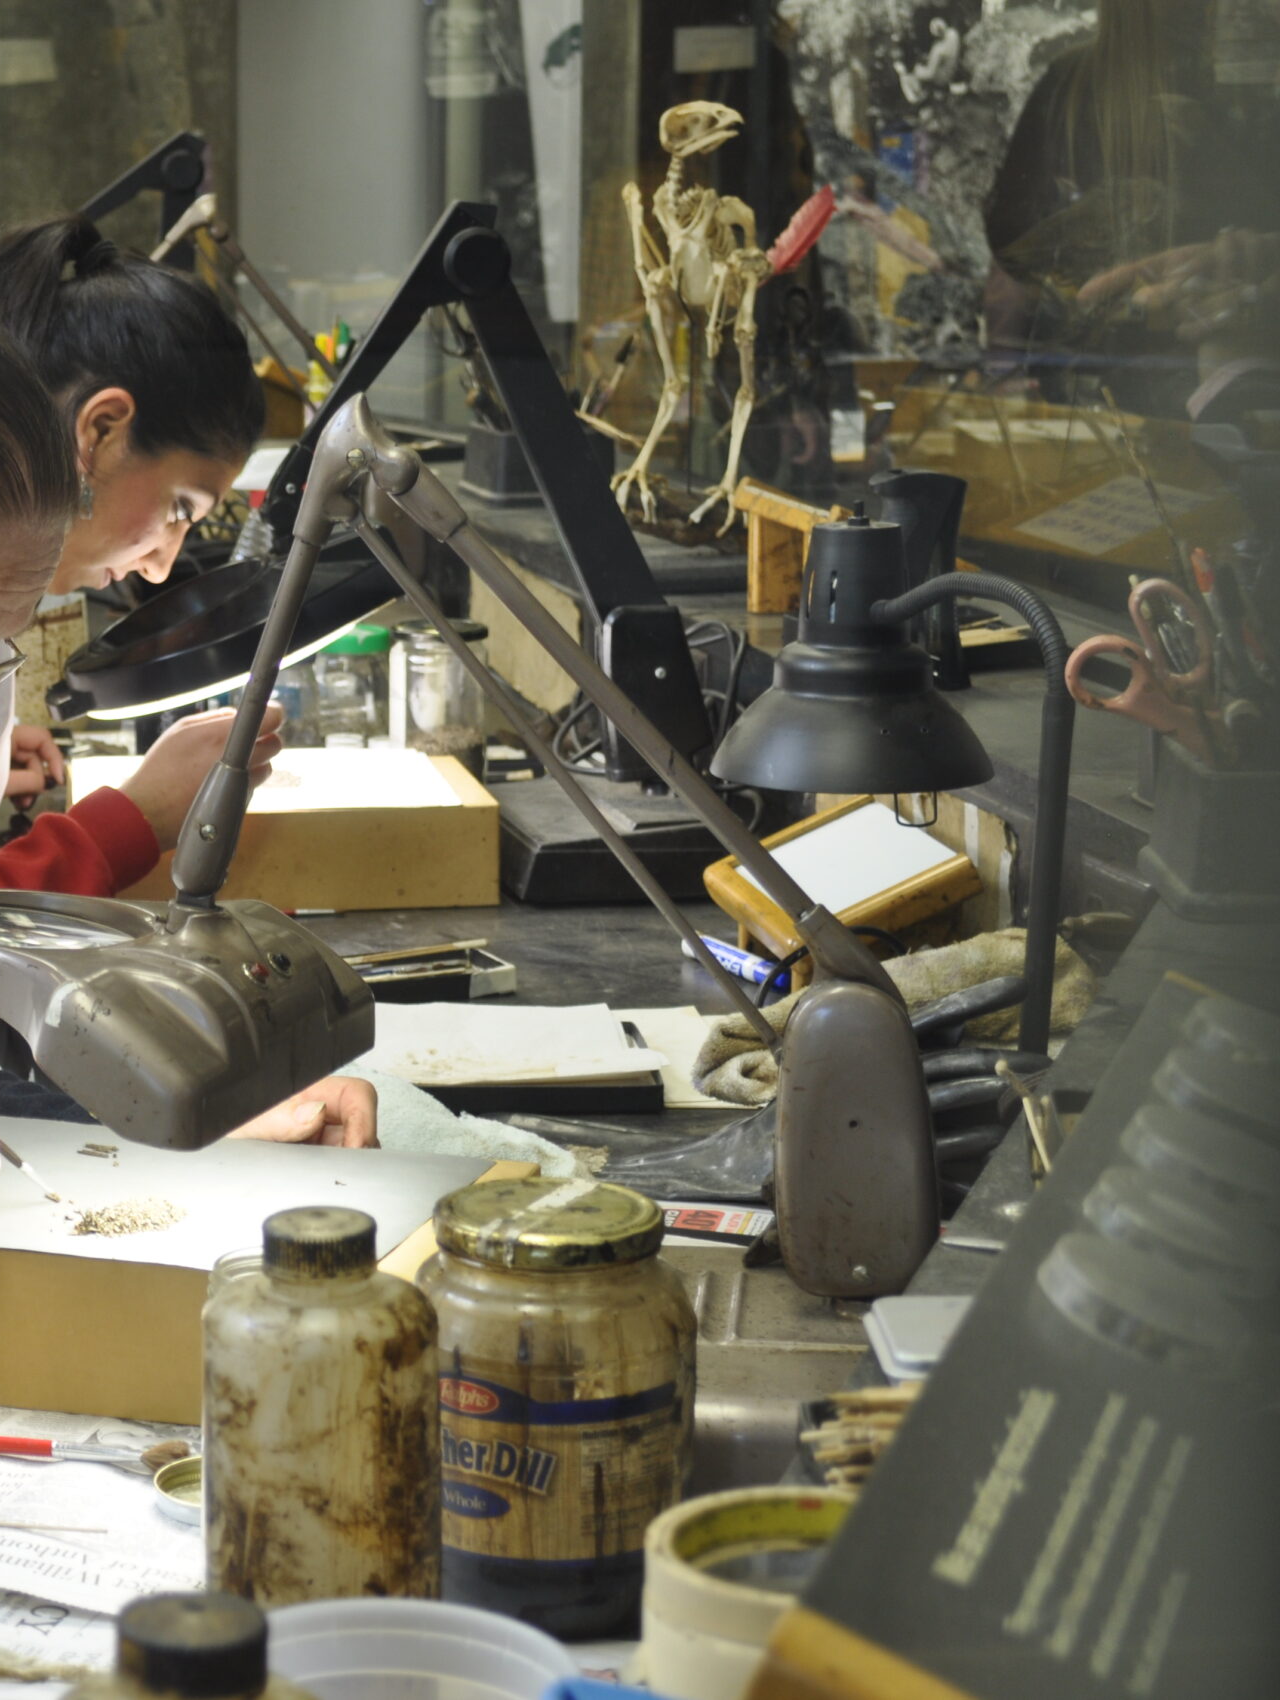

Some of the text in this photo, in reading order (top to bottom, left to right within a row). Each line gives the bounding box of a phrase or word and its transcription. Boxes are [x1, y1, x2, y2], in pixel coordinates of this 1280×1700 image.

[441, 1427, 490, 1474] her
[491, 1440, 558, 1496] Dill
[442, 1488, 487, 1511] Whole
